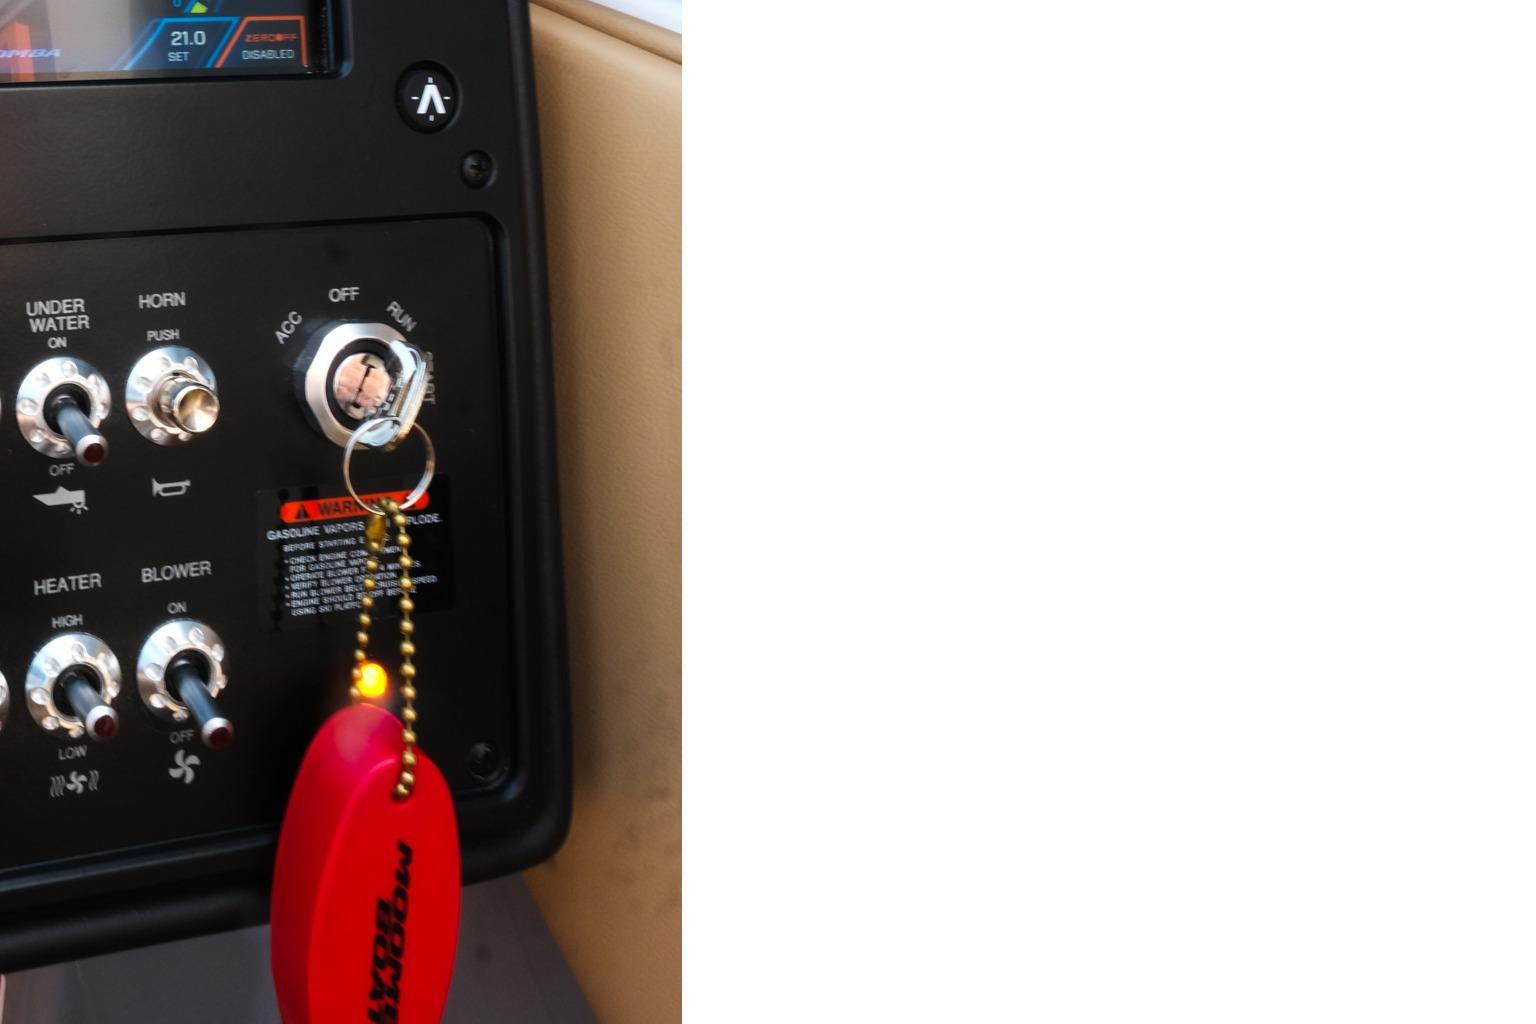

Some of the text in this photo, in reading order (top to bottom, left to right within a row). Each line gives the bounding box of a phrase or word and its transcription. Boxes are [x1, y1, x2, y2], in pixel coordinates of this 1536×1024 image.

[170, 31, 206, 46] 21.0
[168, 51, 190, 62] SET
[242, 49, 295, 60] DISABLED
[138, 291, 186, 309] HORN
[328, 286, 360, 303] OFF
[26, 298, 86, 317] UNDER
[29, 314, 90, 333] WATER
[386, 300, 417, 333] RUN
[146, 328, 180, 343] PUSH
[274, 311, 303, 345] ACC
[48, 336, 68, 350] ON
[49, 463, 75, 477] OFF
[141, 561, 212, 583] BLOWER
[33, 573, 102, 596] HEATER
[167, 601, 187, 614] ON
[51, 613, 83, 629] HIGH
[169, 729, 195, 744] OFF
[58, 744, 88, 761] LOW
